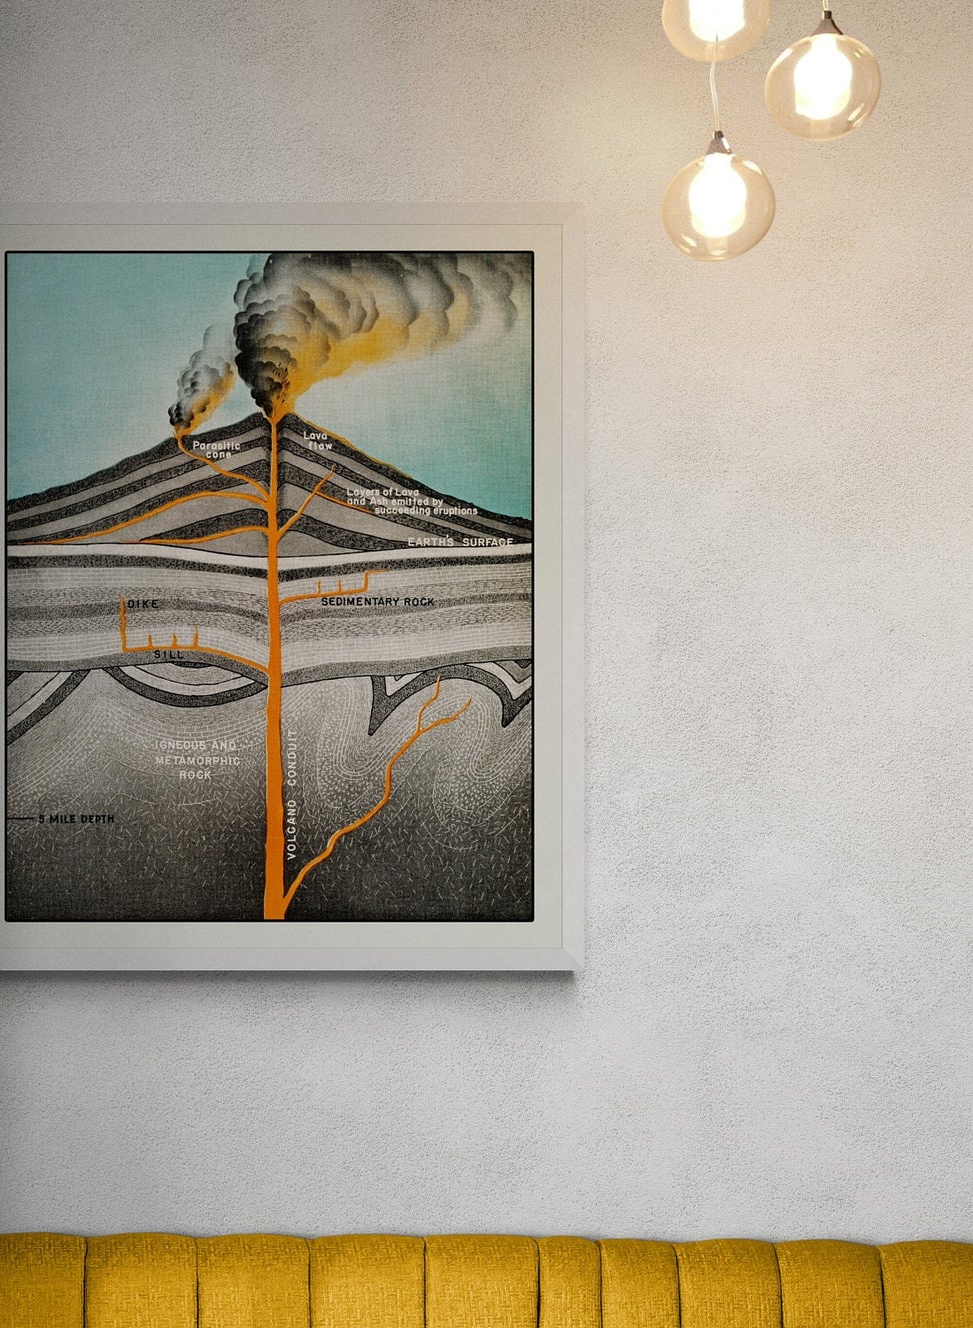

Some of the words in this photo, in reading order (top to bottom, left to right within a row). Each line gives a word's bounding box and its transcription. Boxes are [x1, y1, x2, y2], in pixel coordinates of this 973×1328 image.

[303, 431, 328, 440] Lava
[192, 440, 241, 451] Parasitic
[308, 441, 333, 450] flow
[206, 450, 232, 459] cone
[346, 488, 380, 498] Layers
[382, 487, 393, 496] of
[395, 488, 419, 496] Lava
[347, 497, 366, 505] and
[369, 497, 389, 505] Ash
[391, 497, 429, 506] emitted
[432, 497, 444, 508] by
[374, 506, 431, 516] succeeding
[433, 506, 478, 516] eruptions
[408, 535, 454, 547] EARTH'S
[462, 537, 514, 547] SURFACE
[128, 599, 159, 609] DIKE
[321, 597, 399, 606] SEDIMENTARY
[404, 597, 435, 606] ROCK
[154, 650, 184, 660] SILL
[155, 740, 206, 750] IGNEOUS
[211, 740, 236, 750] AND
[155, 756, 241, 766] METAMORPHIC
[287, 730, 297, 786] CONDUIT
[179, 770, 212, 780] ROCK
[38, 814, 45, 824] 5
[49, 814, 76, 824] MILE
[81, 814, 115, 824] DEPTH
[287, 799, 297, 861] VOLCANO
